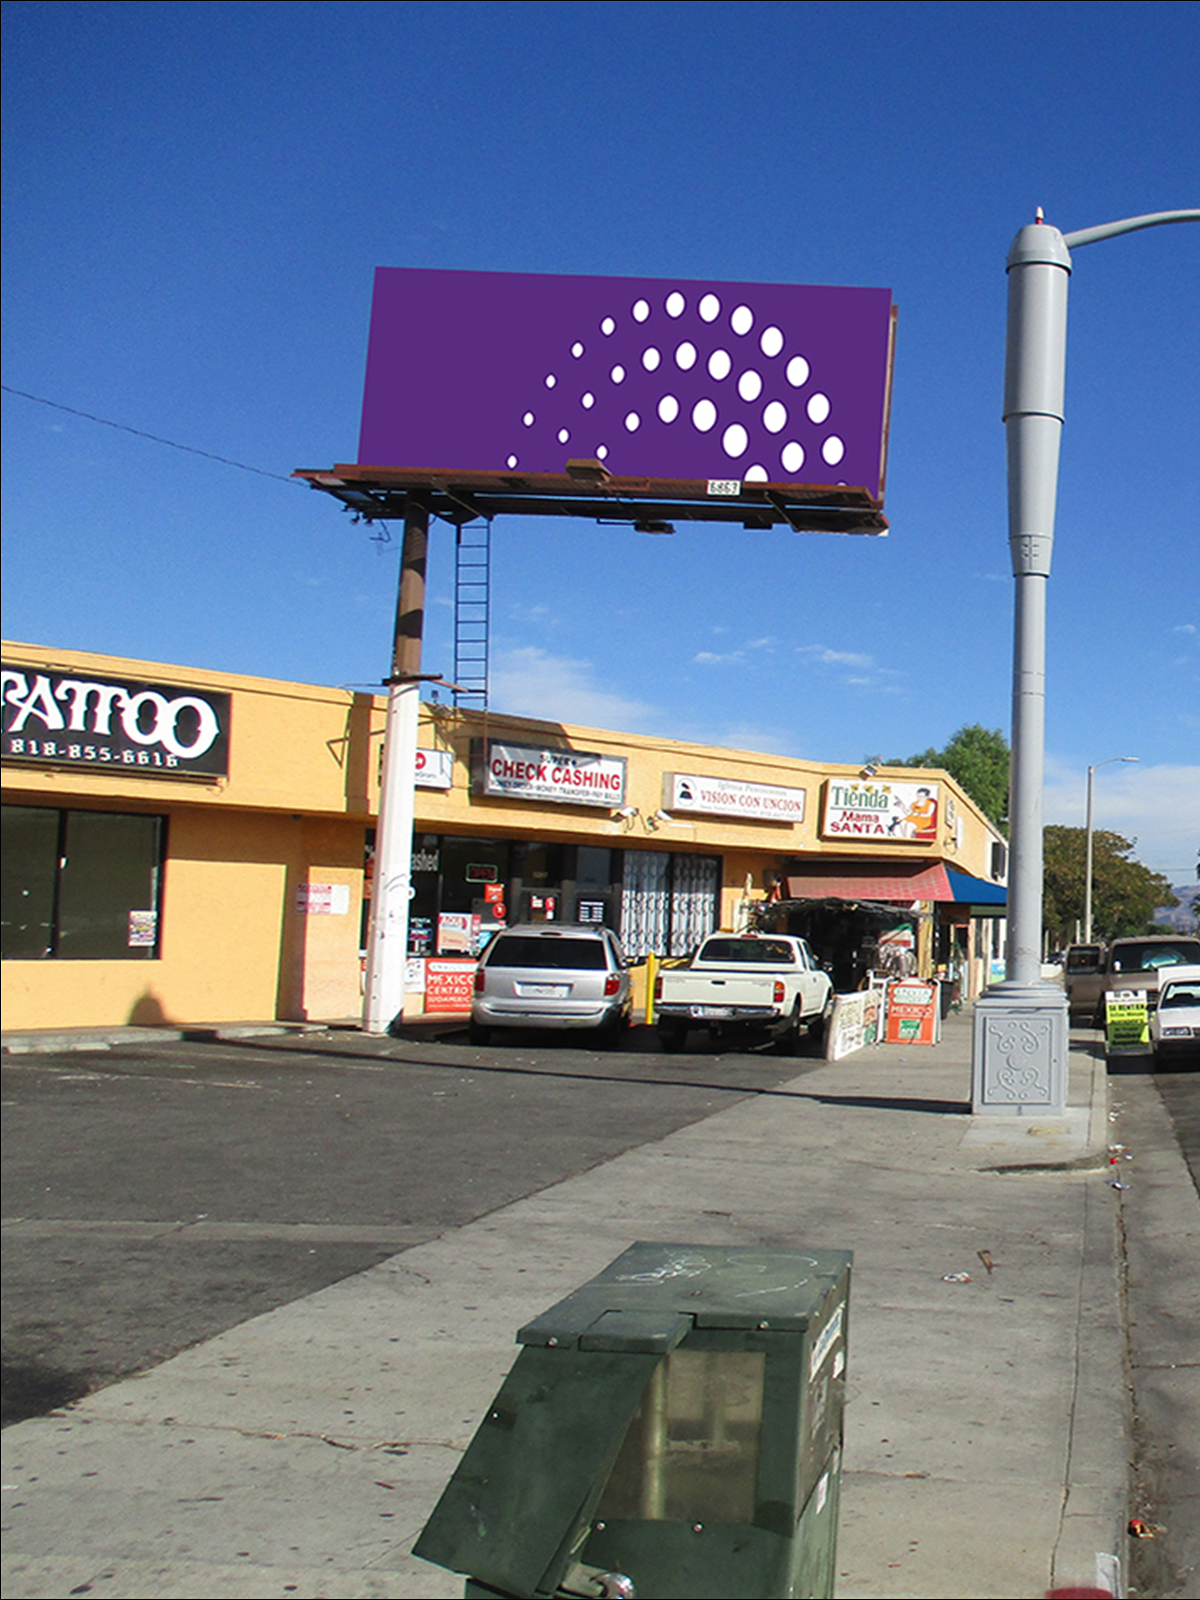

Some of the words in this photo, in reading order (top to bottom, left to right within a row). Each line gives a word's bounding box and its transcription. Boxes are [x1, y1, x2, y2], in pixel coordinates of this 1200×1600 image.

[11, 738, 179, 767] 818-855-6616
[492, 758, 547, 782] CHECK
[551, 767, 621, 791] CASHING
[700, 790, 736, 805] VISION
[739, 794, 760, 807] CON
[763, 797, 801, 812] UNCION
[831, 786, 889, 809] Tienda
[831, 821, 884, 834] SANTA
[840, 810, 880, 823] Mama
[428, 986, 469, 995] CENTRO
